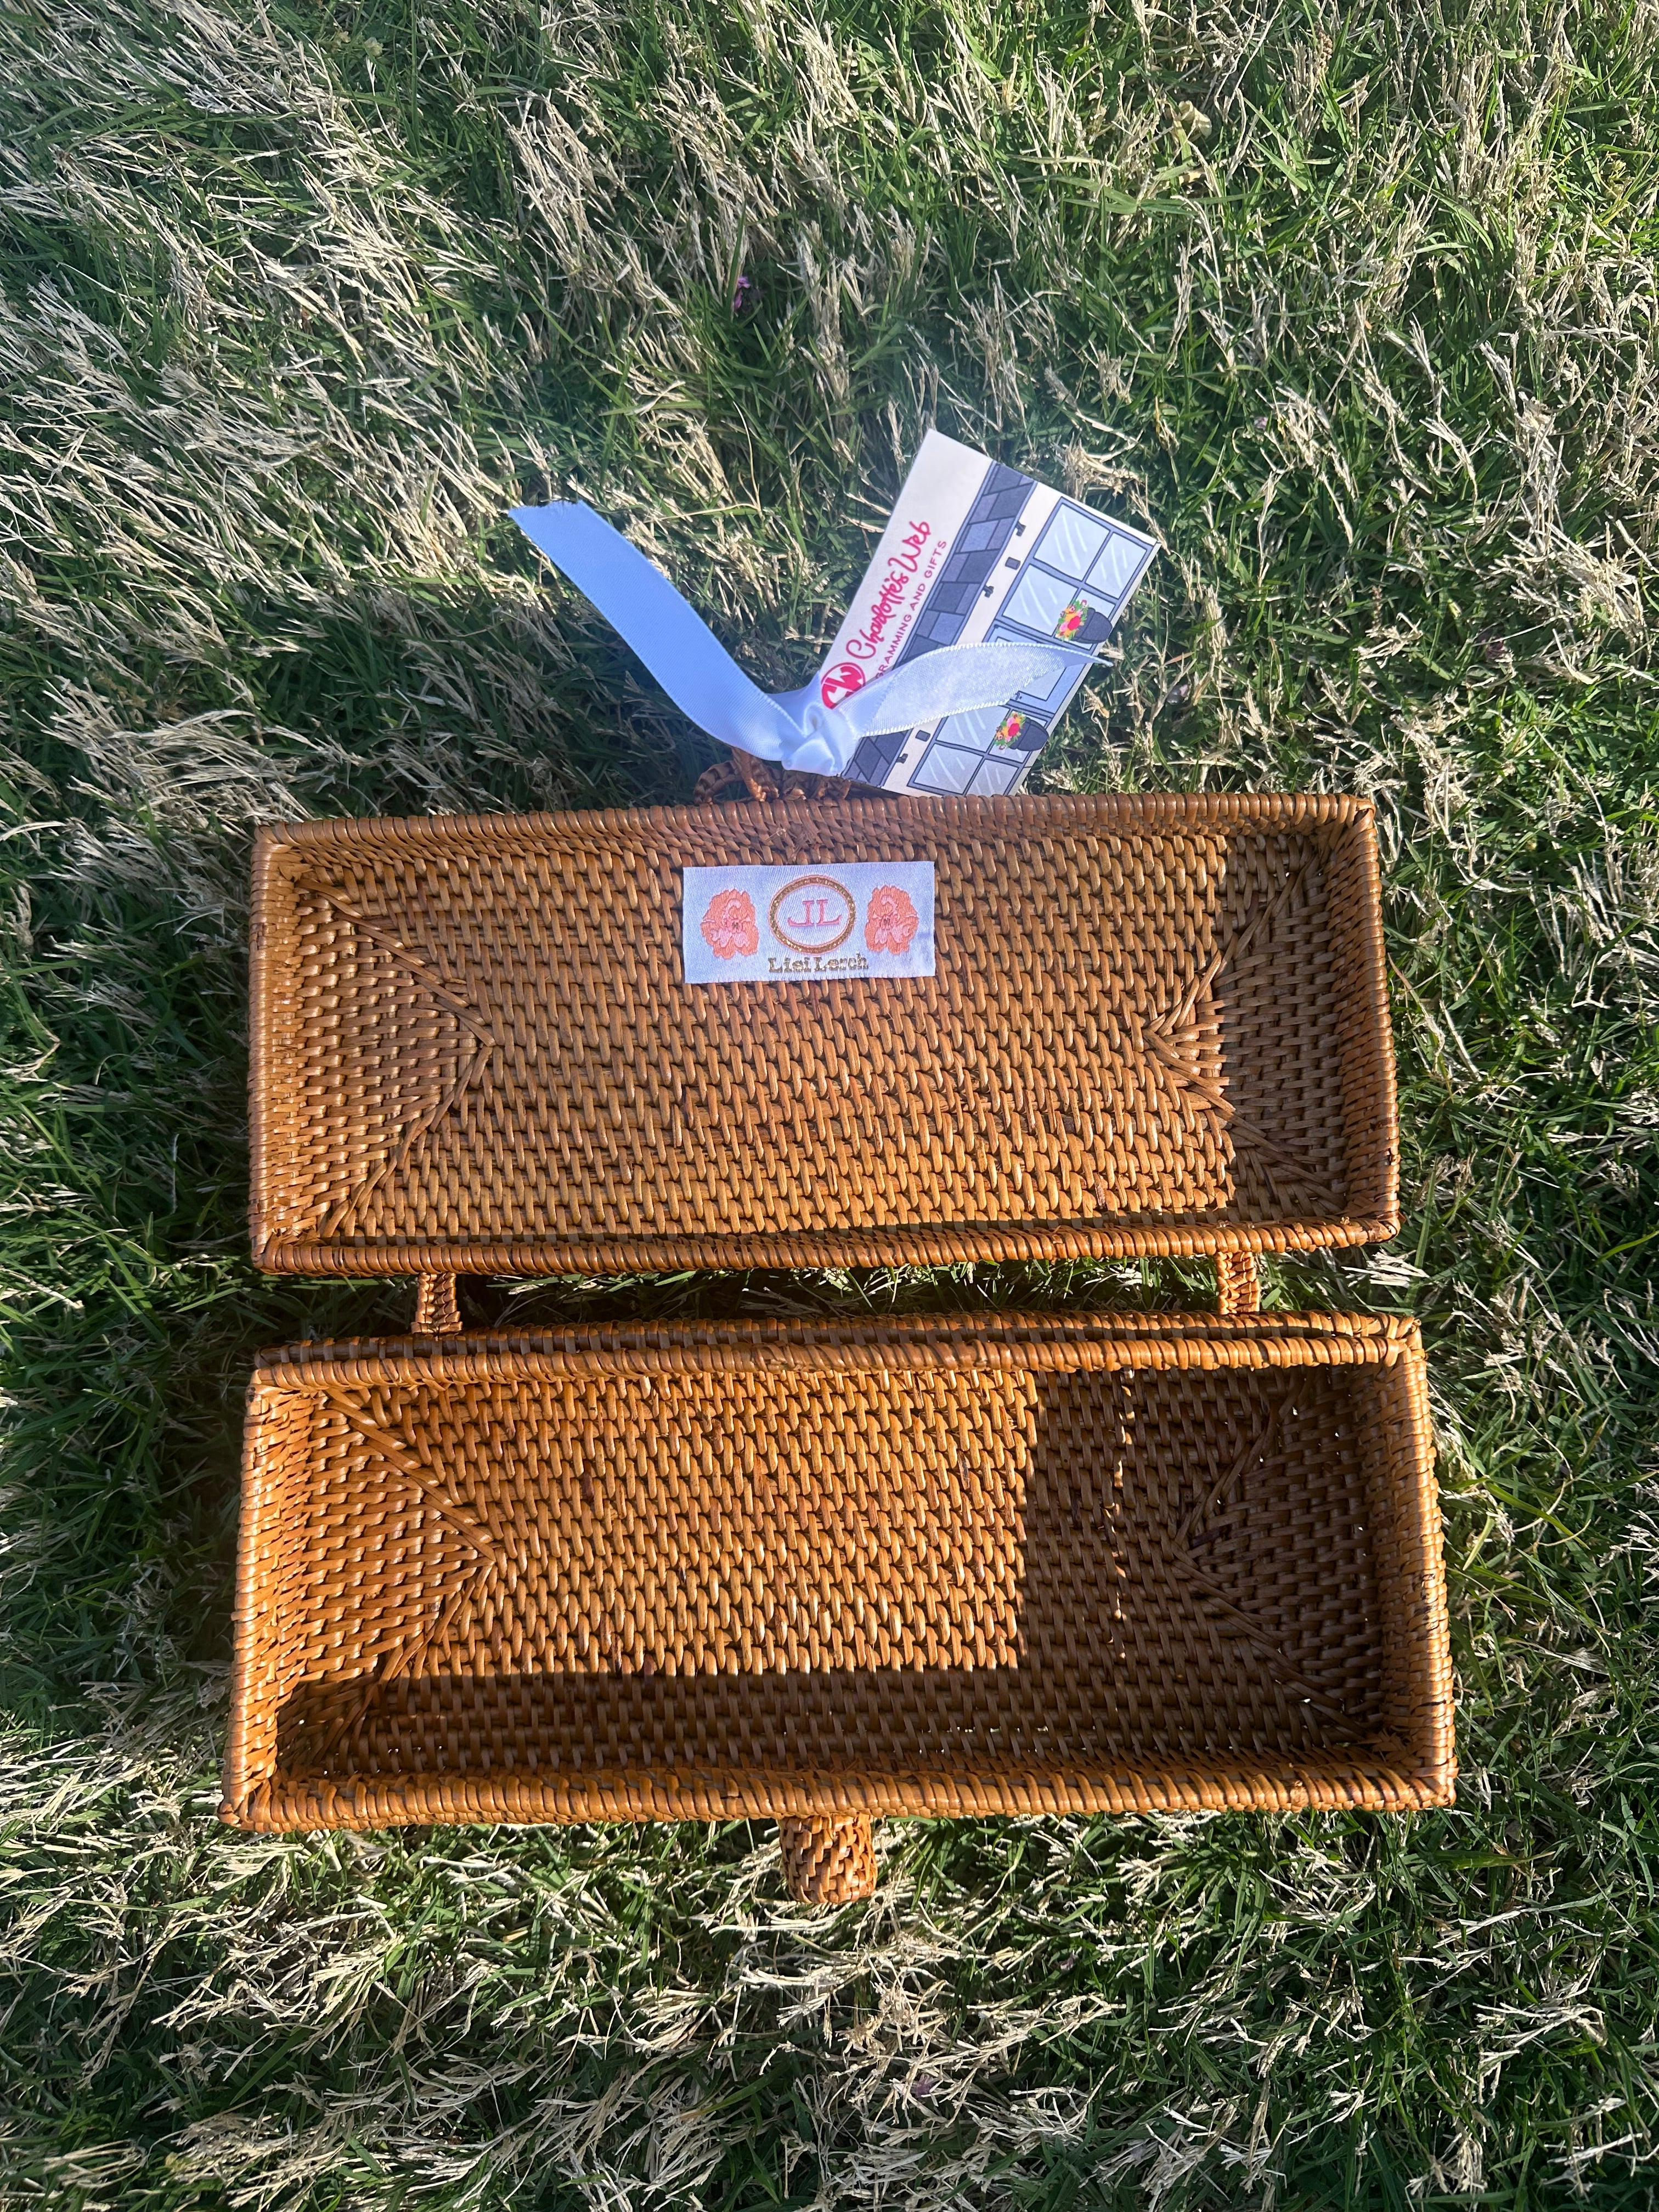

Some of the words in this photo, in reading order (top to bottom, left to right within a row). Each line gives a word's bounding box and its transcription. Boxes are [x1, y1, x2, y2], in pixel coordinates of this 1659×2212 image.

[845, 570, 910, 659] Charlotte's
[888, 520, 932, 573] Web
[909, 583, 926, 611] AND
[924, 540, 947, 579] GIFTS
[813, 952, 870, 972] Lerch
